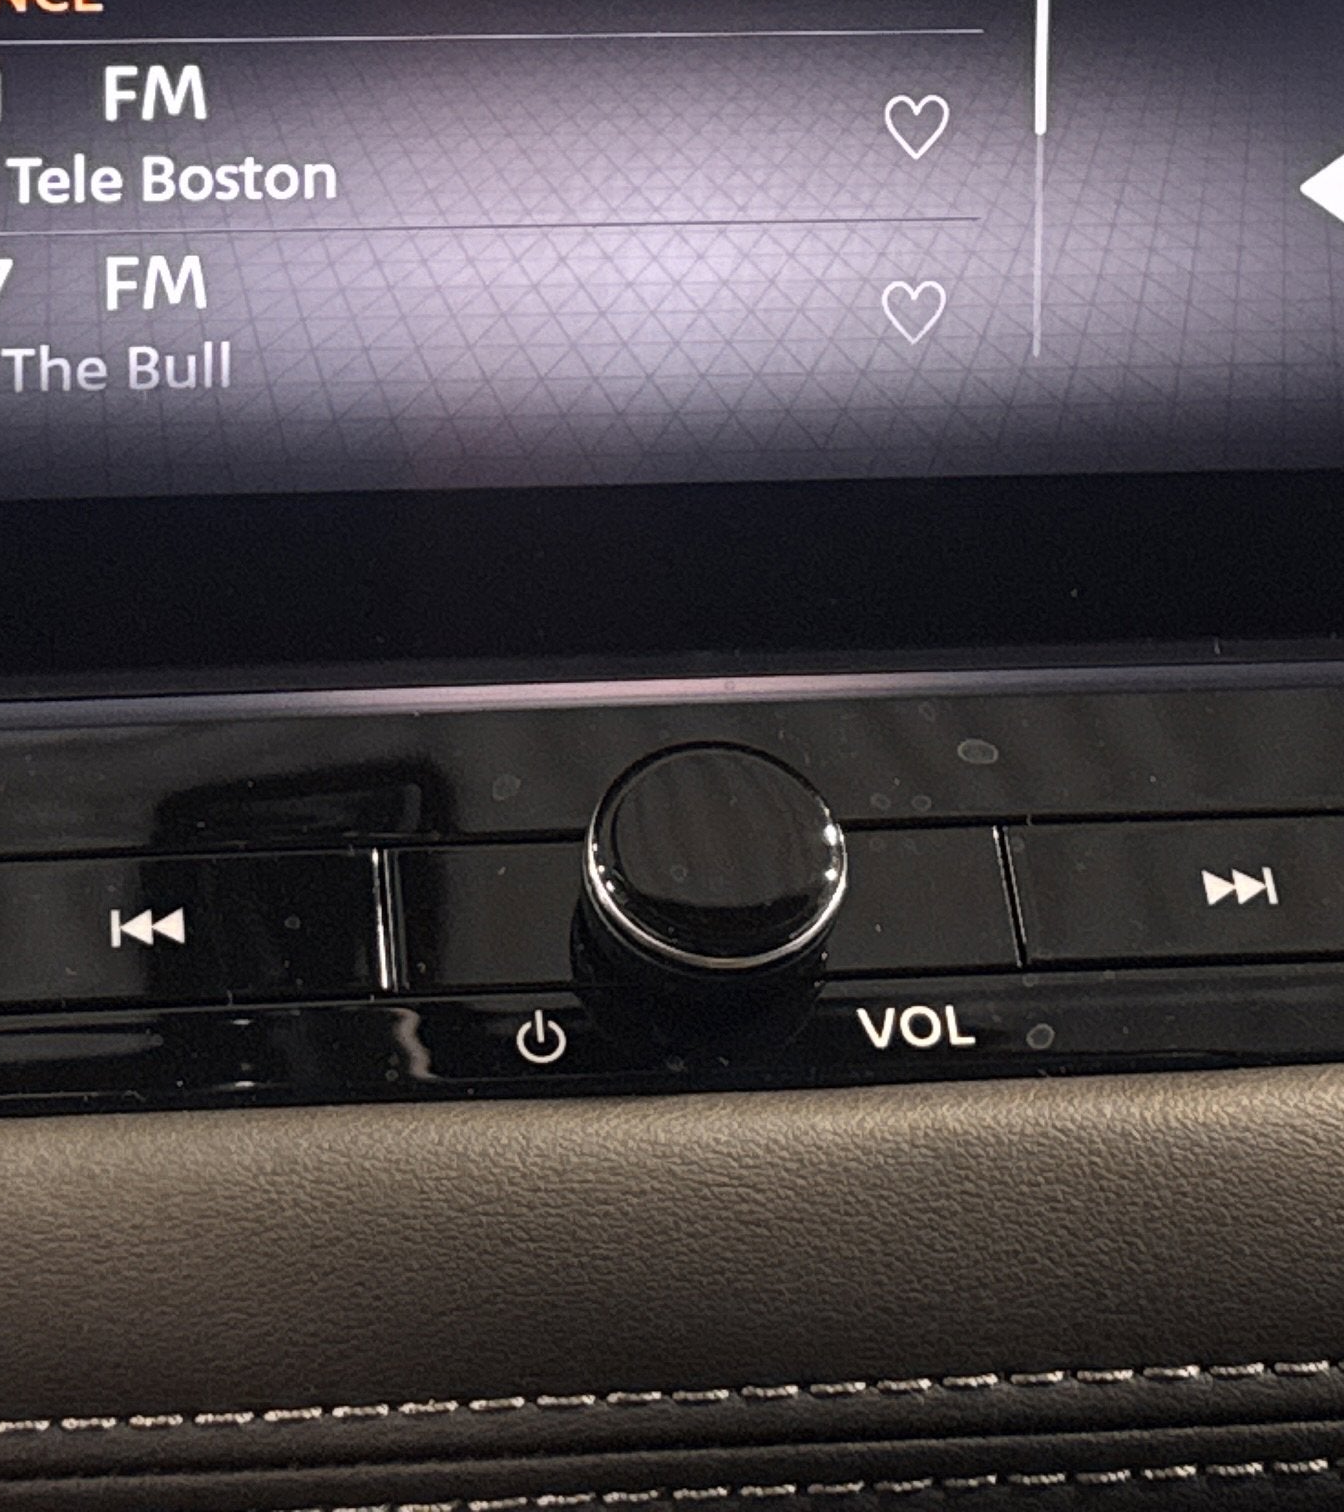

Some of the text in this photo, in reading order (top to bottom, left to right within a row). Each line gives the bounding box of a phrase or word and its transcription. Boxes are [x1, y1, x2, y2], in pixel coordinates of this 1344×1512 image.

[105, 65, 207, 122] FM
[6, 153, 123, 204] Tele
[142, 156, 338, 203] Boston
[107, 255, 207, 310] FM
[1, 345, 107, 391] The
[129, 341, 230, 389] Bull
[857, 1005, 975, 1048] VOL
